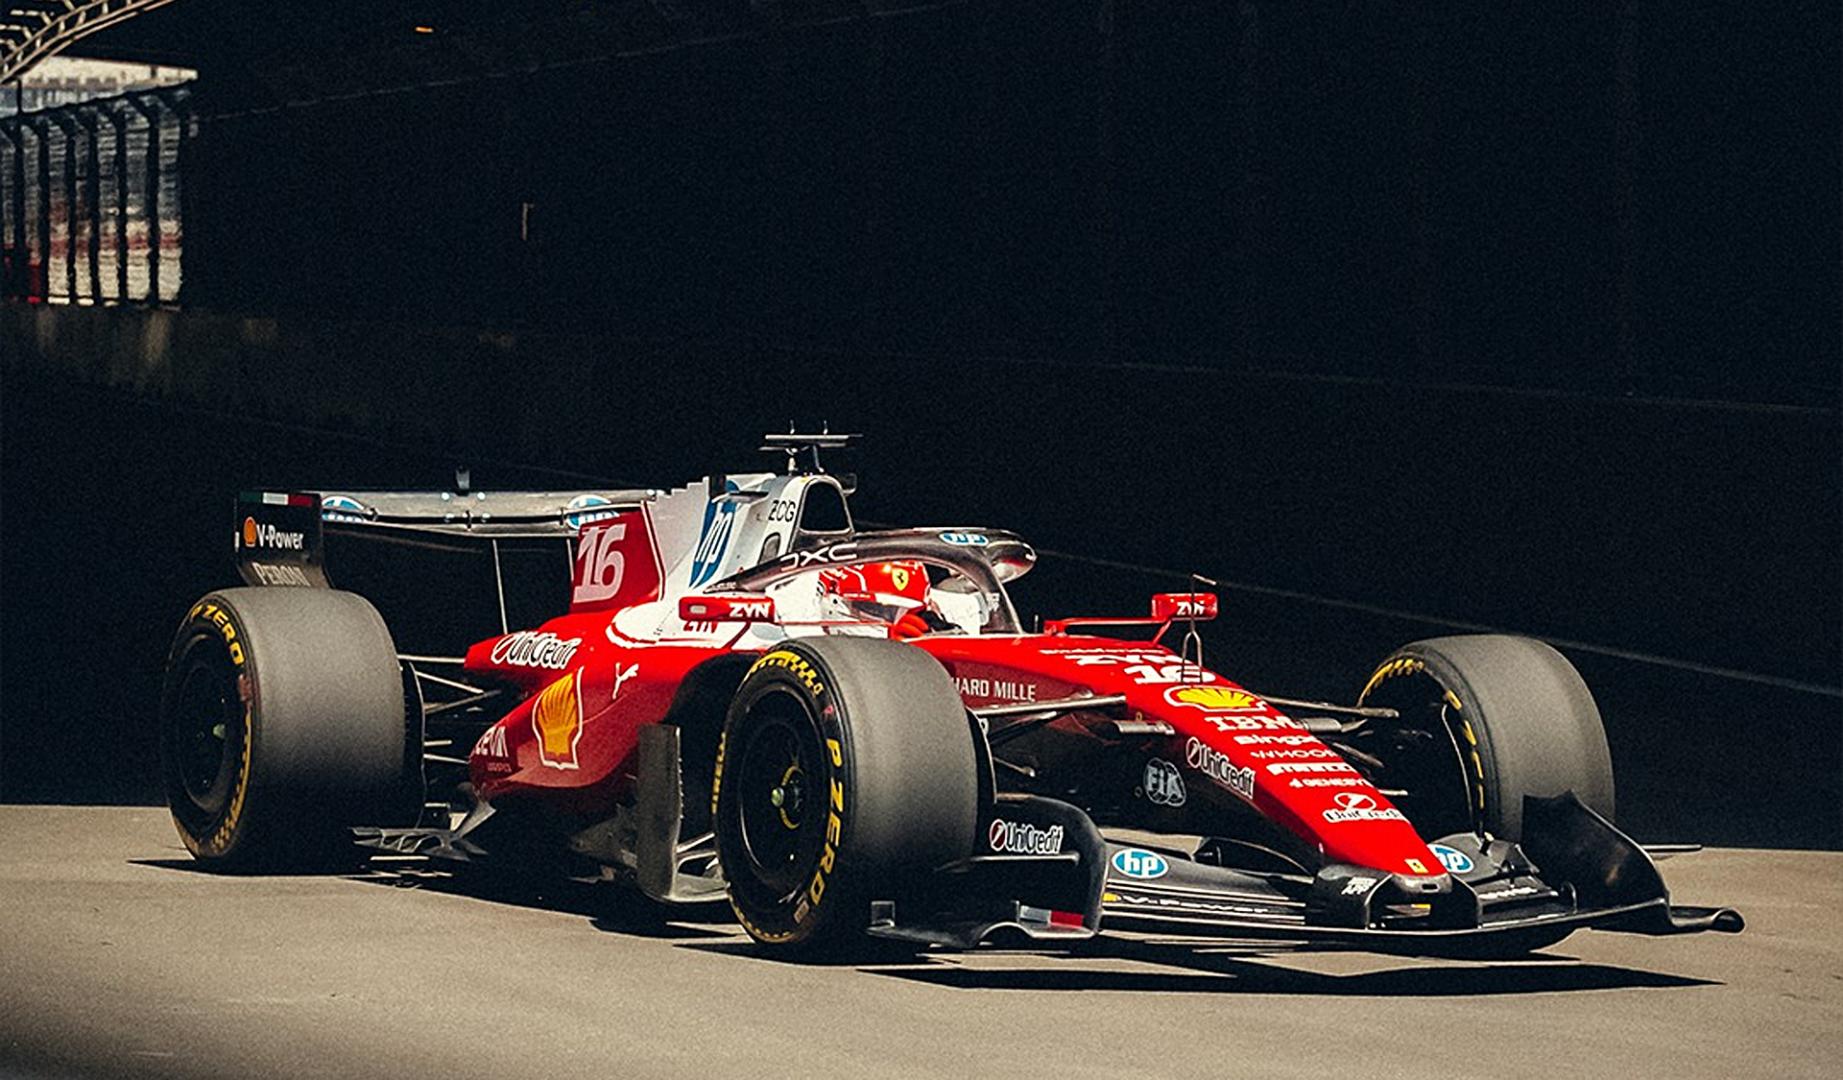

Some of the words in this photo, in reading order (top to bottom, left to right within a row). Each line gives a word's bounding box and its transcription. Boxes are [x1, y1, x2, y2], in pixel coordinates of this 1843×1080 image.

[768, 499, 796, 522] ZCG
[256, 523, 305, 550] V-Power
[689, 500, 733, 589] hp
[573, 523, 627, 603] 16
[729, 602, 771, 618] ZYN
[202, 603, 246, 667] ZERO
[1124, 665, 1216, 684] 16
[993, 681, 1036, 702] MILLE
[1205, 716, 1305, 731] IBM
[826, 738, 843, 768] P
[1148, 765, 1183, 798] FIA
[1201, 743, 1256, 799] UniCredit
[810, 777, 844, 906] ZERO
[1005, 823, 1064, 856] UniCredit
[1122, 848, 1160, 878] hp
